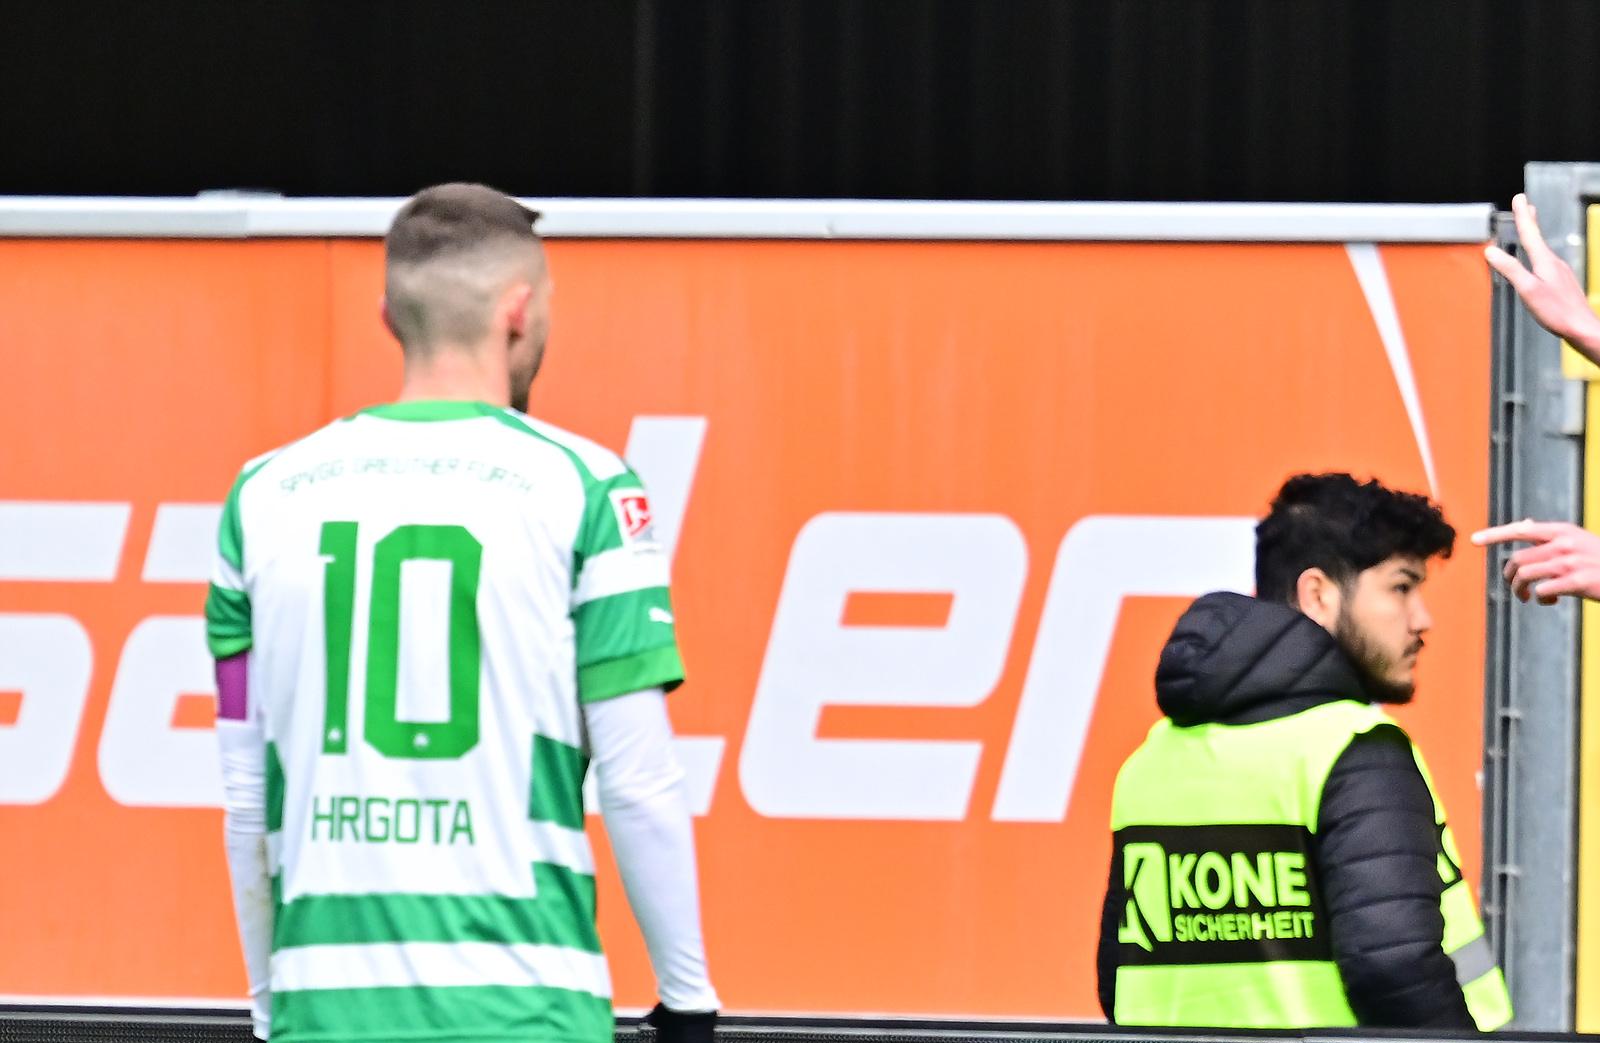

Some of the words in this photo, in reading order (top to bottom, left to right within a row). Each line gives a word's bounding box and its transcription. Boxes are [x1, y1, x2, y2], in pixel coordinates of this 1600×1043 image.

[319, 520, 484, 761] 10
[312, 796, 476, 846] HRGOTA
[1168, 851, 1311, 910] KONE
[1174, 910, 1315, 943] SICHERHEIT
